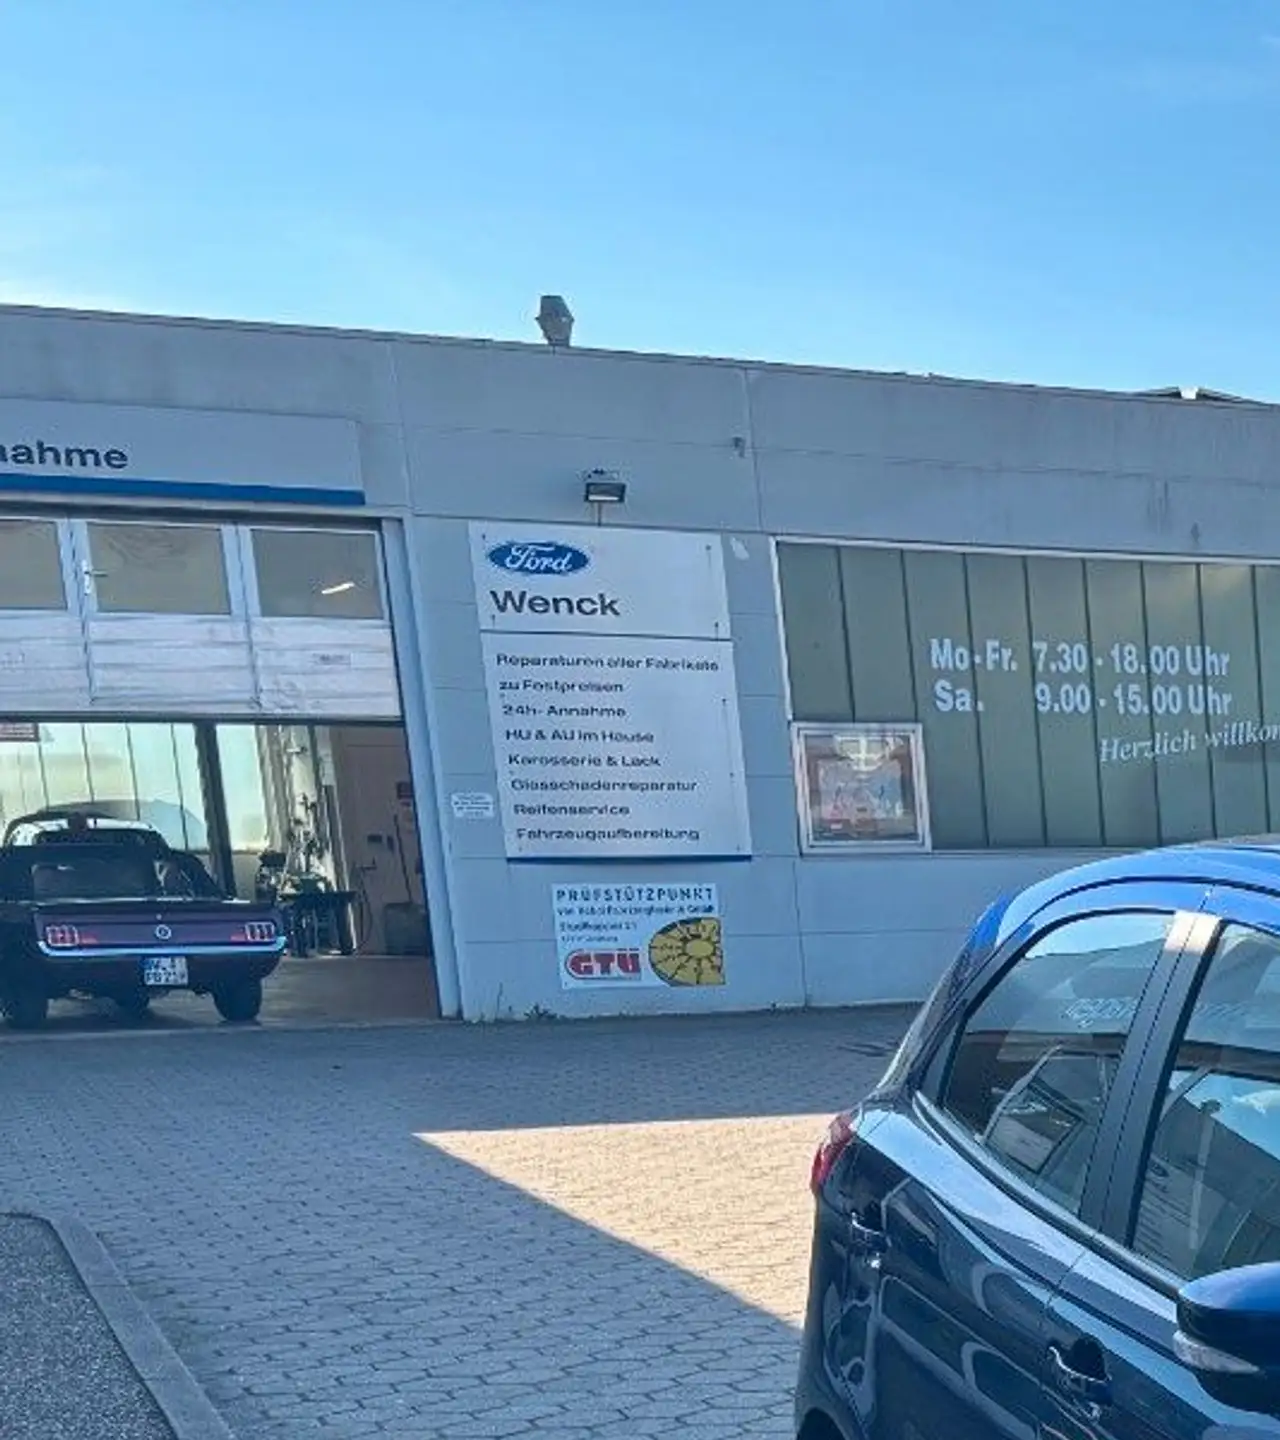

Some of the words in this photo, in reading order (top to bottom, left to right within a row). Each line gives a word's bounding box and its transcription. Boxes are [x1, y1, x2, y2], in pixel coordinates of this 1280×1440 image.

[505, 544, 573, 572] Ford
[489, 589, 621, 616] Wenck
[496, 654, 604, 668] Reparaturen
[646, 657, 719, 671] Fabrikate
[1033, 641, 1089, 674] 7.30
[1110, 642, 1180, 676] 18.00
[1185, 645, 1230, 676] Uhr
[499, 681, 519, 691] zu
[523, 679, 624, 694] Festpreisen
[934, 679, 985, 713] Sa.
[1035, 682, 1092, 714] 9.00
[1112, 683, 1183, 716] 15.00
[1187, 685, 1233, 716] Uhr
[547, 705, 627, 718] Annahme
[506, 729, 531, 741] HU
[535, 730, 547, 741] &
[551, 730, 575, 741] AU
[578, 730, 599, 742] im
[1099, 729, 1198, 762] Herzlich
[508, 754, 602, 767] Karosserie
[606, 756, 618, 767] &
[621, 755, 662, 767] Lack
[511, 778, 698, 793] Glasschadenreparatur
[513, 803, 631, 816] Reifenservice
[516, 827, 700, 842] Fahrzeugaufbereitung
[567, 948, 642, 976] GTÜ
